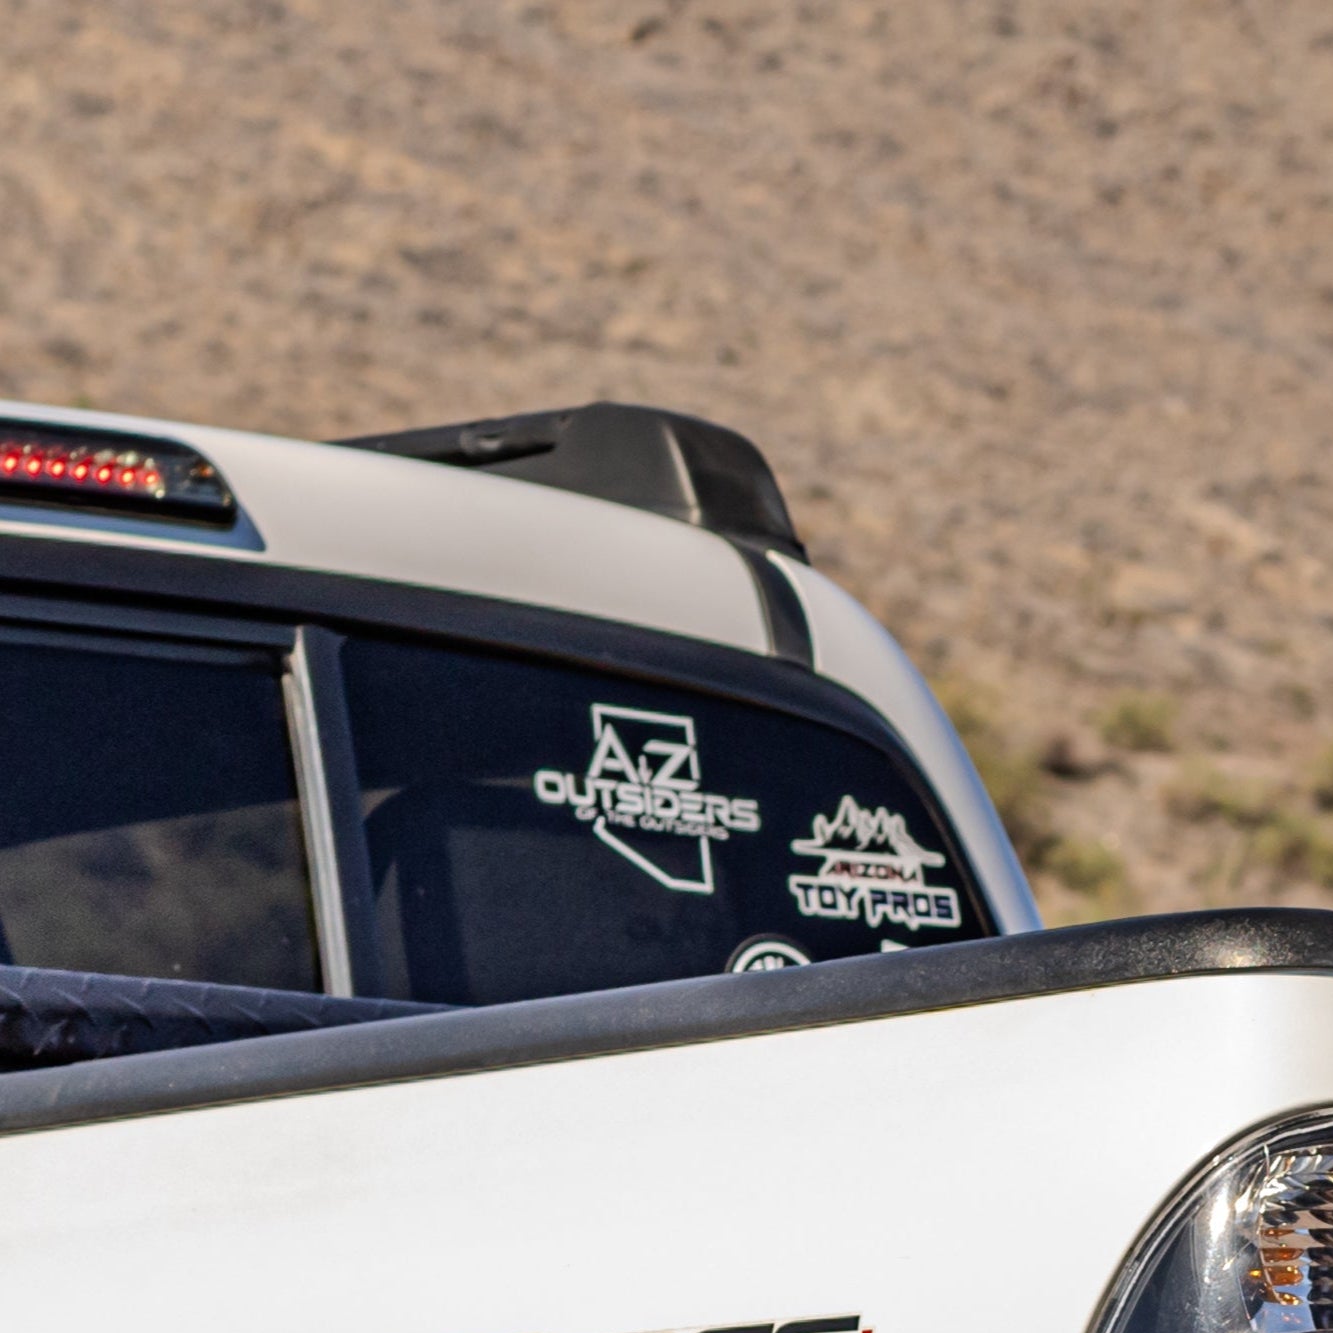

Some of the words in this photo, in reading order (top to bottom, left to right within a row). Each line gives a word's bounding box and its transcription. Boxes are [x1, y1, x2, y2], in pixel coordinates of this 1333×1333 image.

[534, 770, 761, 832] OUTSIDERS
[796, 883, 857, 911] TOY
[869, 889, 954, 919] PROS
